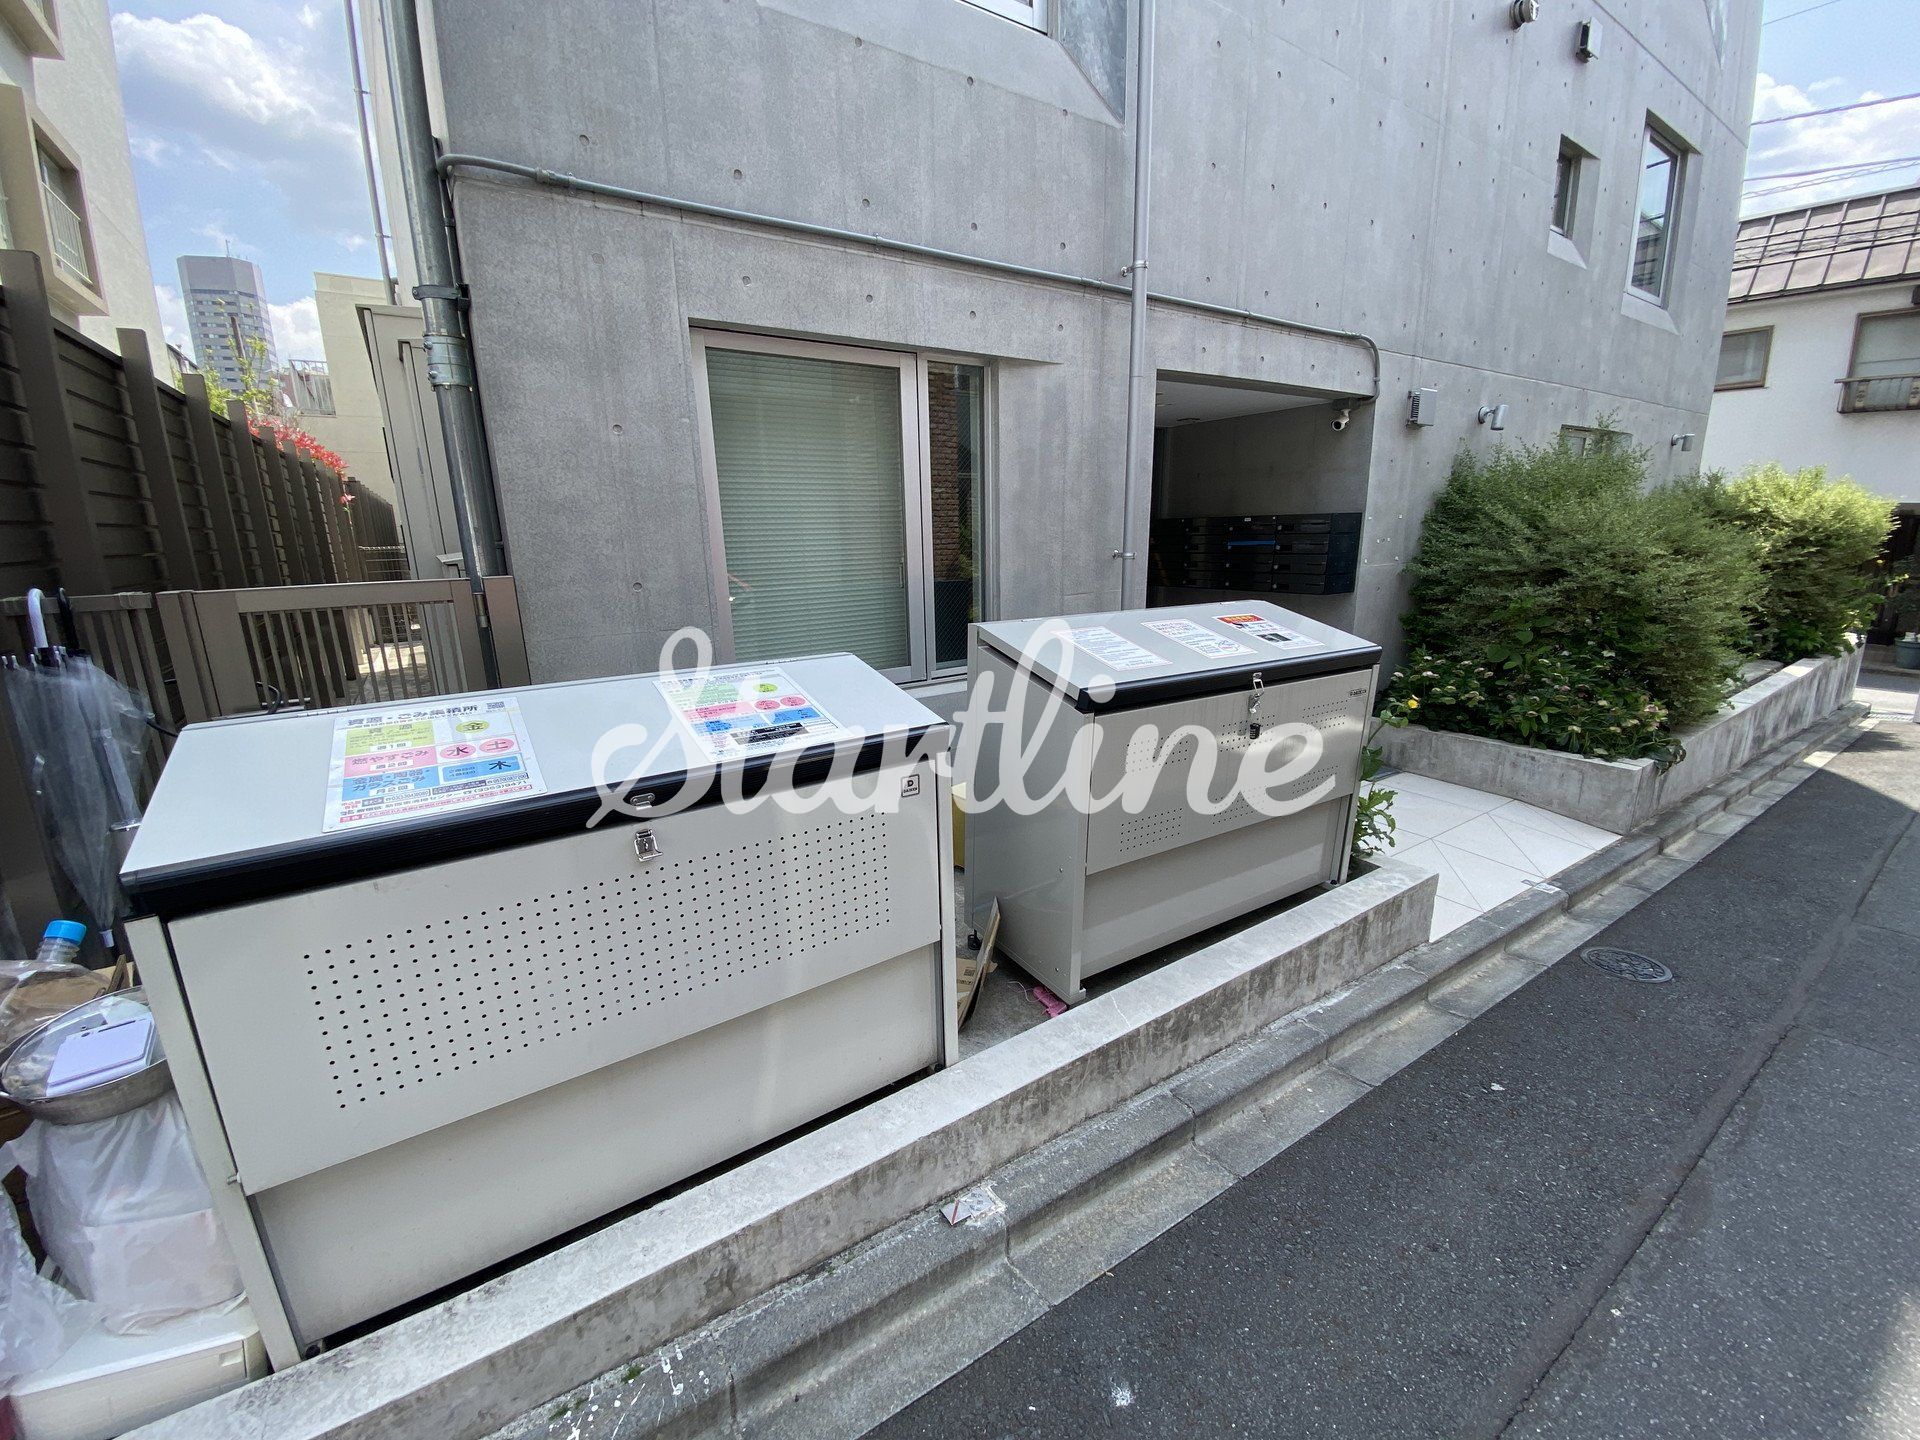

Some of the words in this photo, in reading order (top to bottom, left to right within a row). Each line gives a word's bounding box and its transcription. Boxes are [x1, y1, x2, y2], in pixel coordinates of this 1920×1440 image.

[464, 722, 484, 731] 金
[446, 747, 469, 757] 水
[487, 741, 509, 751] 土
[489, 760, 512, 771] 木
